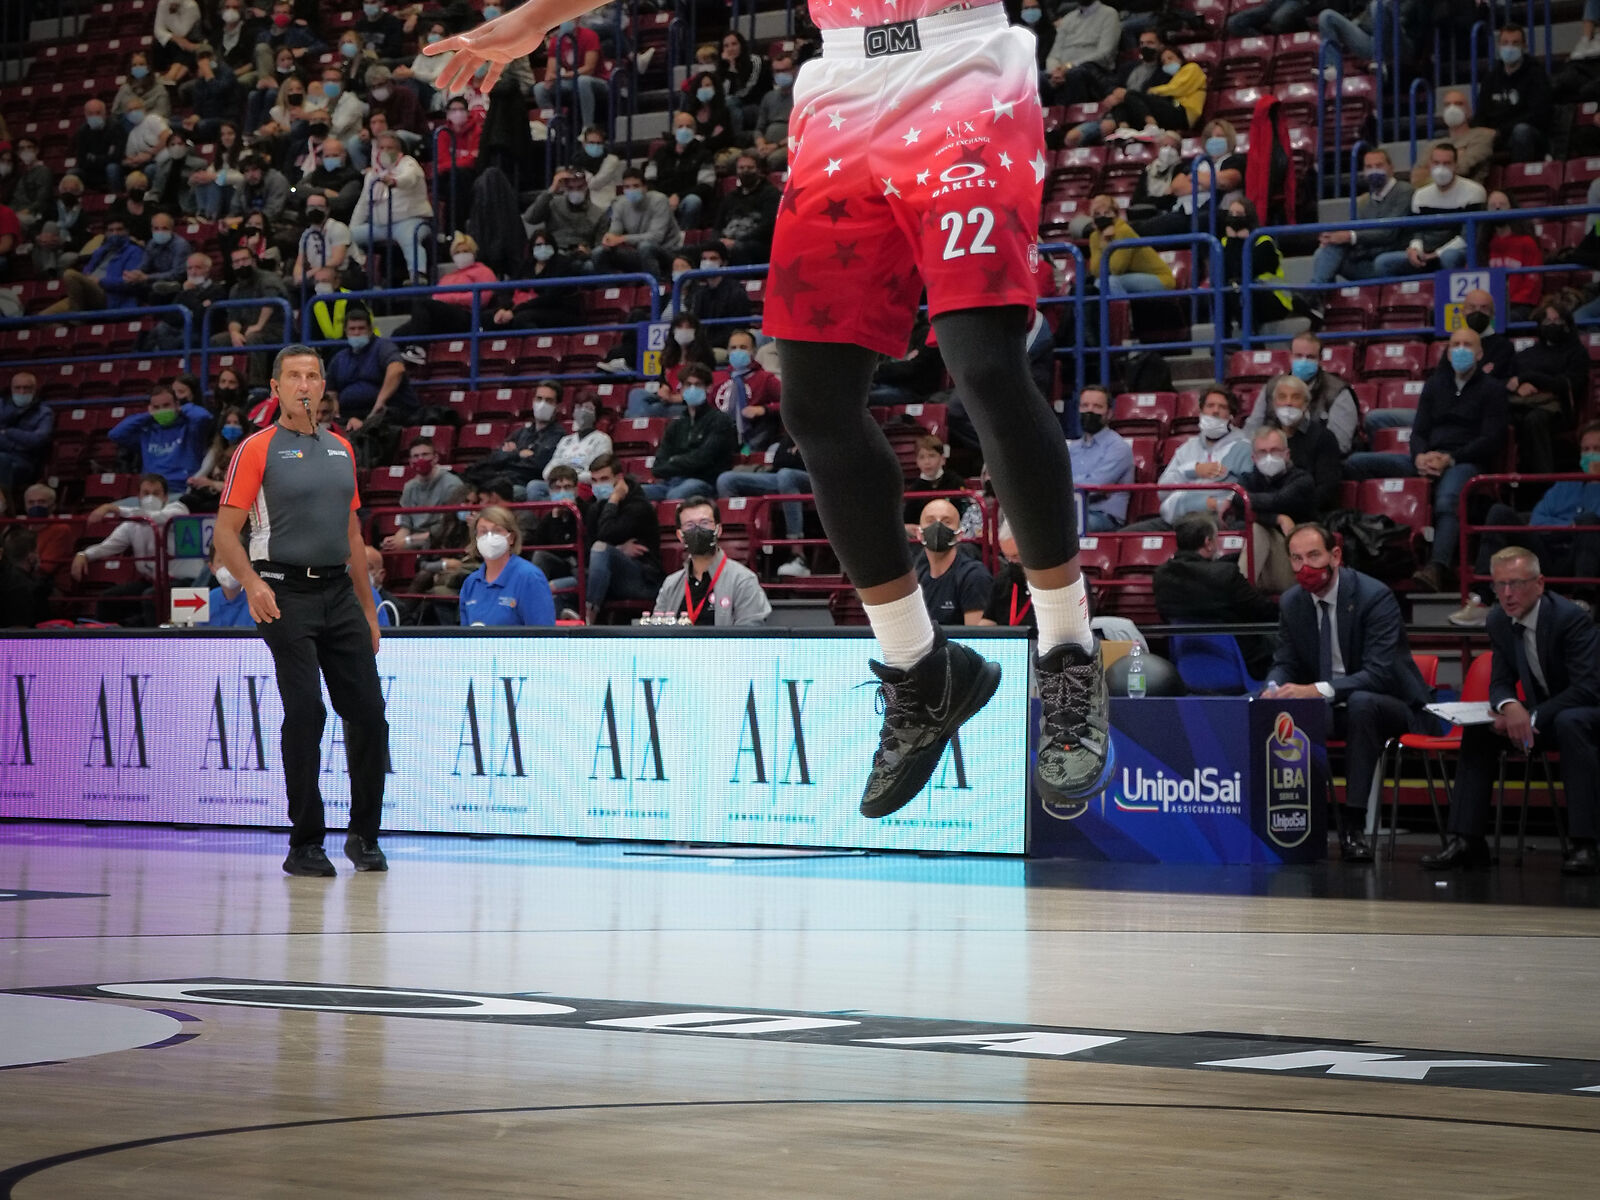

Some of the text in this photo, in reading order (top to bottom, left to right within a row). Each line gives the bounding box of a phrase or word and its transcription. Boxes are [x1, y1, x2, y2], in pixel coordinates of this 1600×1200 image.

[866, 24, 917, 57] OM
[932, 179, 998, 198] OAKLEY
[941, 207, 997, 261] 22
[181, 525, 197, 548] A
[1122, 767, 1242, 813] UnipolSai
[1273, 767, 1306, 790] LBA
[1171, 804, 1242, 815] ASSICURAZIONI
